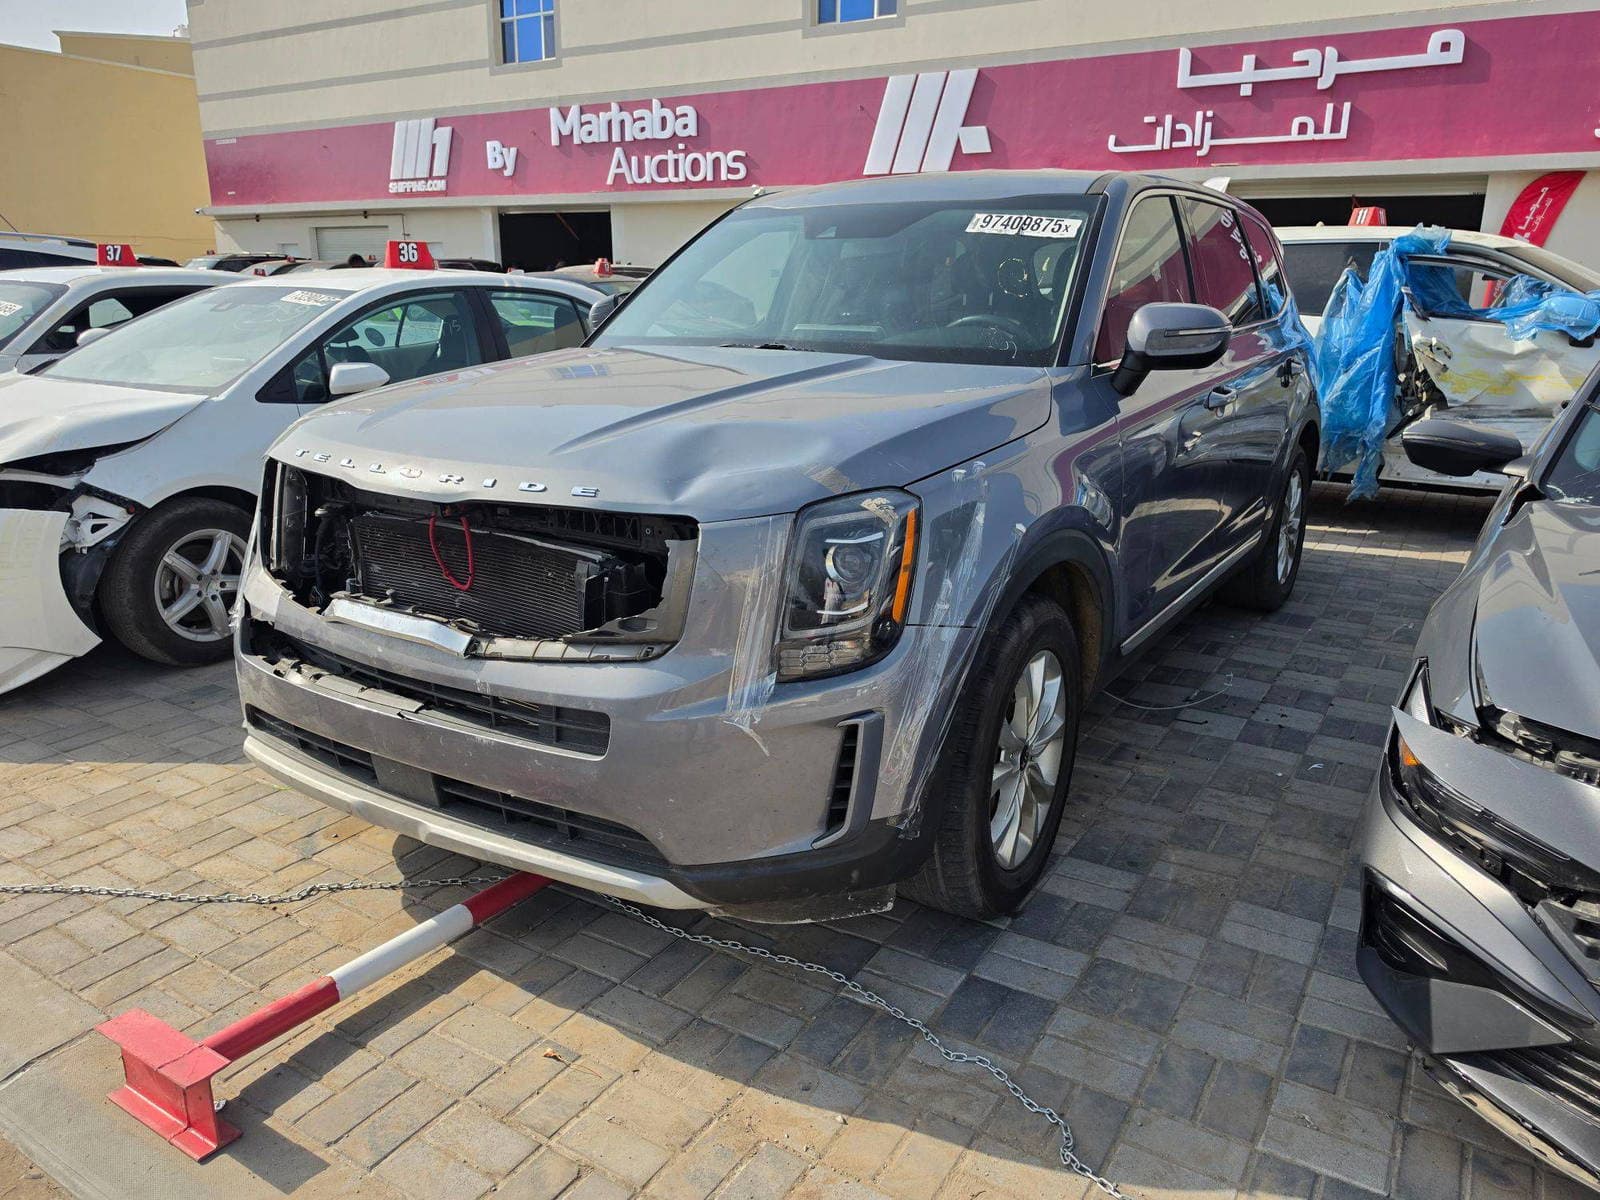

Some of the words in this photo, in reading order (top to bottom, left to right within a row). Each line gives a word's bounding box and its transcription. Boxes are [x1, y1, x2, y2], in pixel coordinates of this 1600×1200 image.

[1176, 29, 1466, 96] مرحبا
[550, 98, 698, 146] Marhaba
[1108, 101, 1351, 156] للمزادات
[486, 140, 518, 177] By
[606, 143, 748, 185] Auctions
[388, 179, 447, 193] SHIPPING.COM
[105, 245, 122, 261] 37
[398, 242, 418, 262] 36
[295, 447, 601, 498] TELLURIDE
